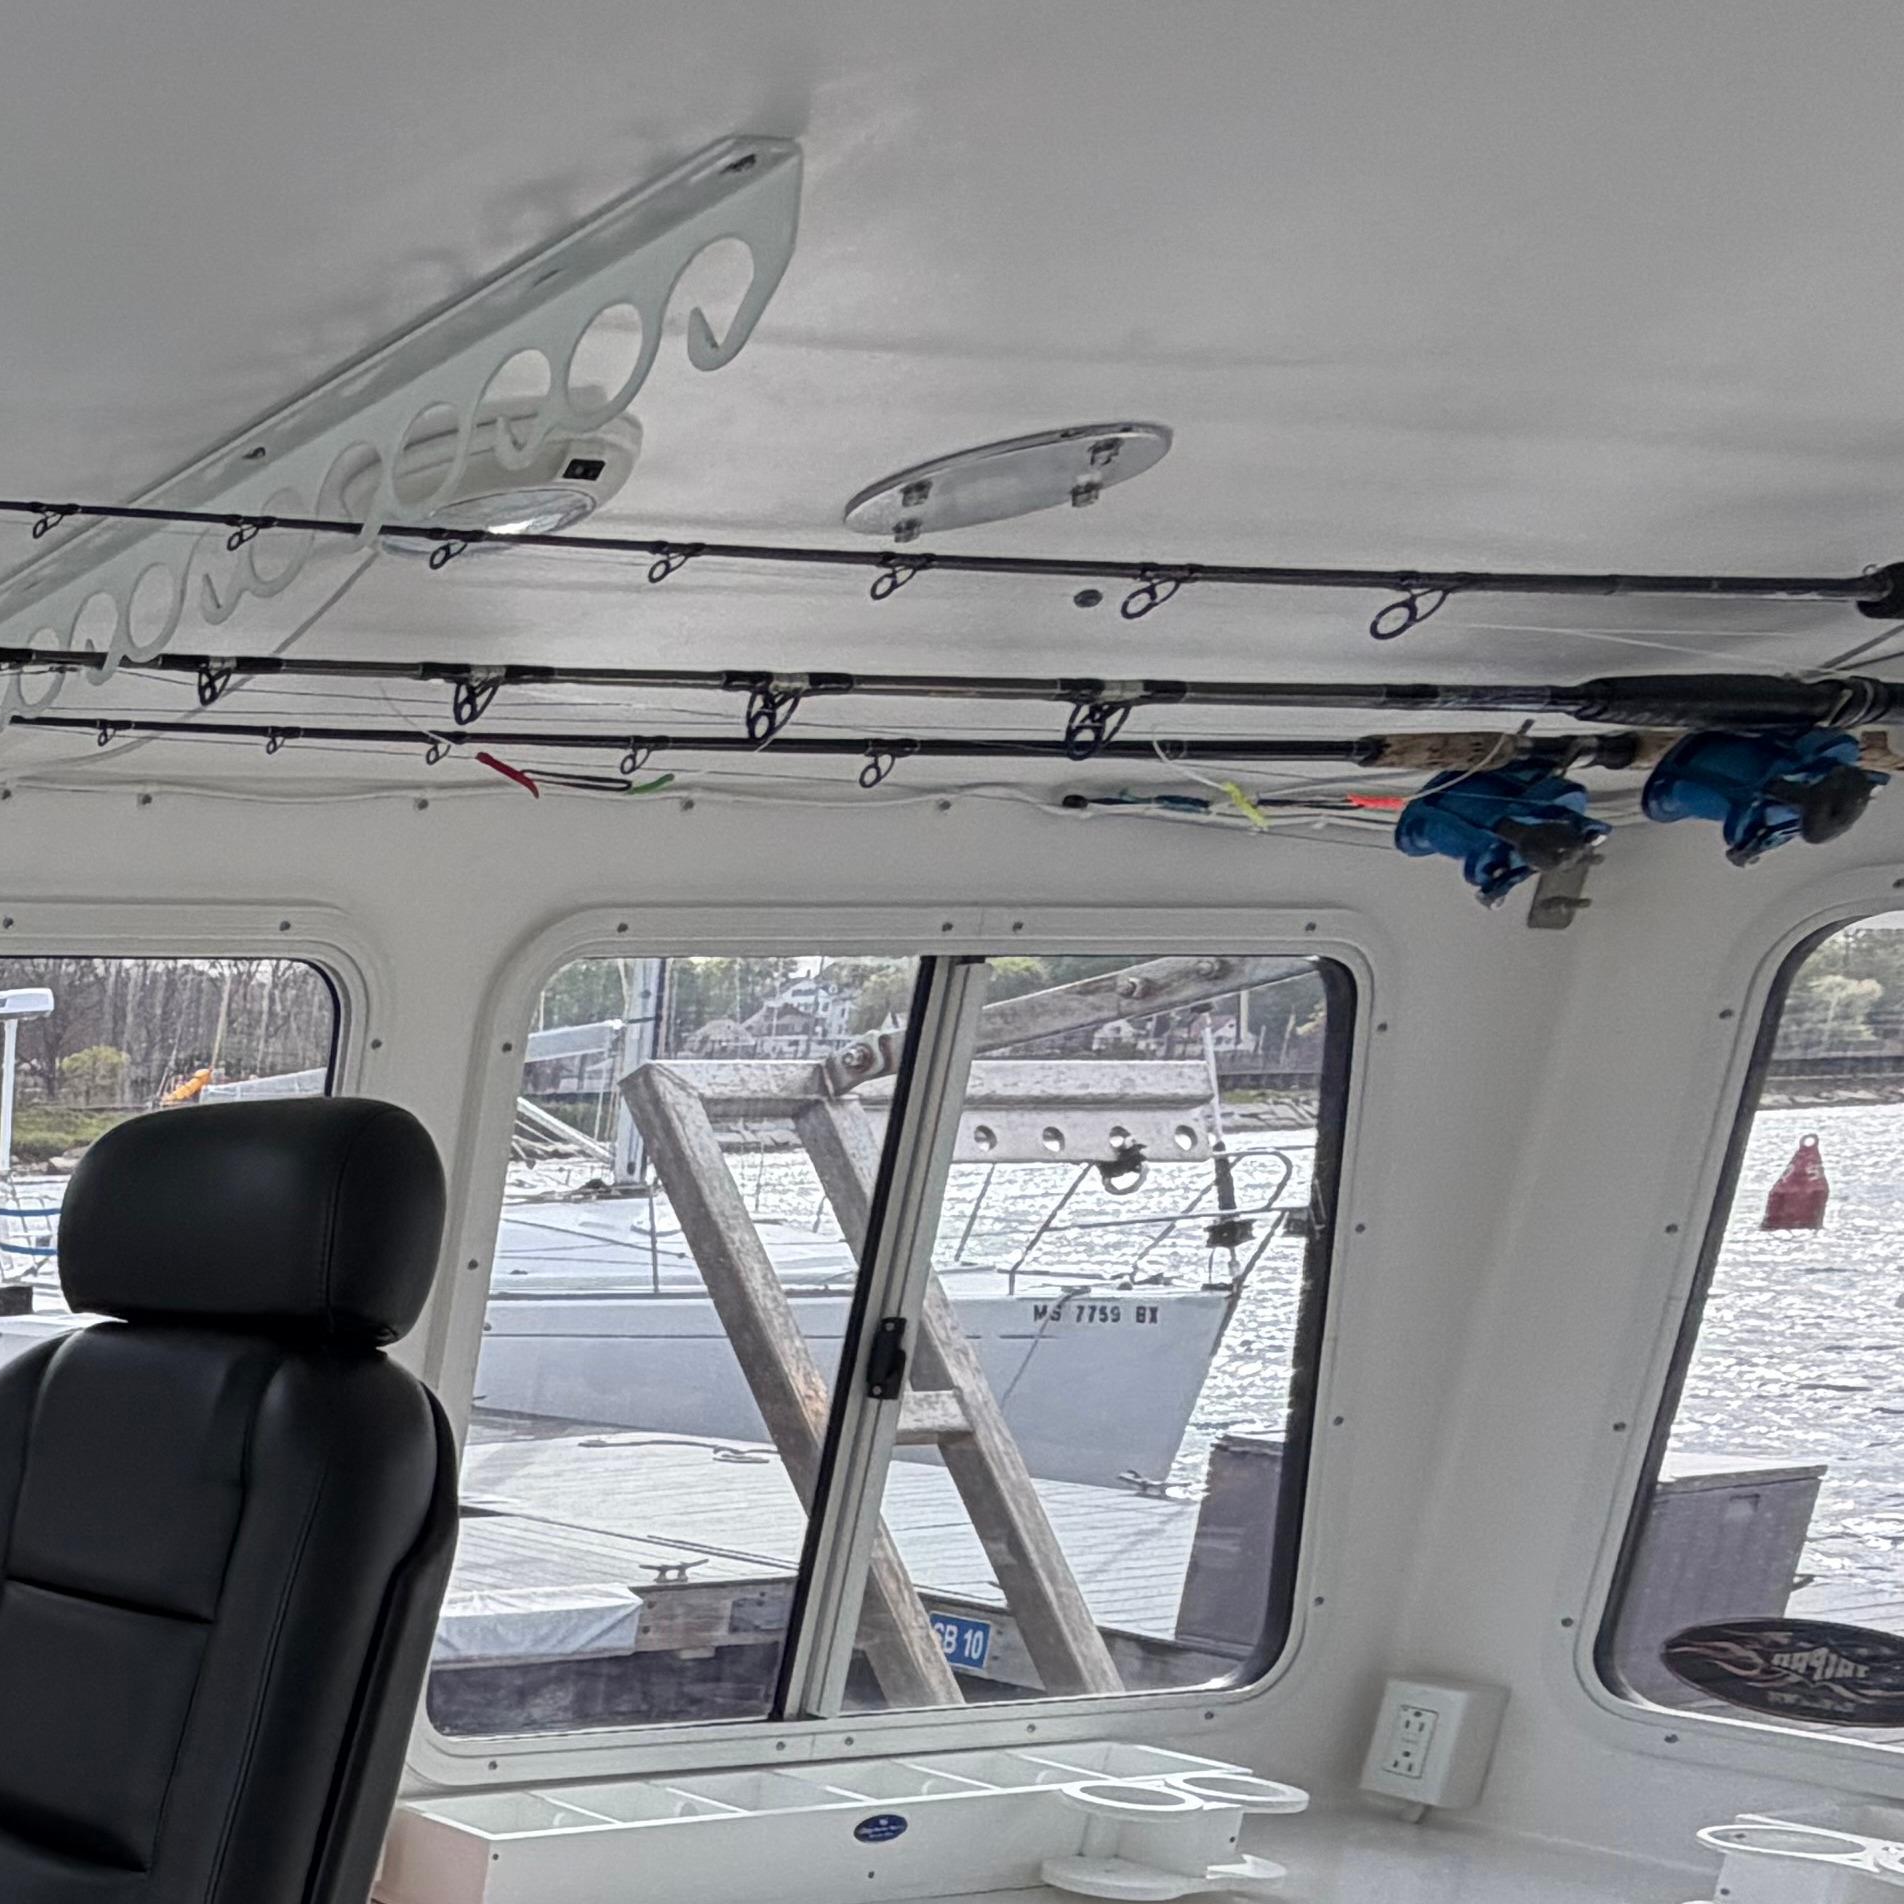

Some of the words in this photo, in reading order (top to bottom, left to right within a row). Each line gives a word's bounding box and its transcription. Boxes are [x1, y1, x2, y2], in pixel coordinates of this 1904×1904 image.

[1033, 1304, 1062, 1322] MS
[1076, 1305, 1121, 1323] 7759
[1135, 1306, 1159, 1324] BX
[964, 1629, 984, 1660] 10
